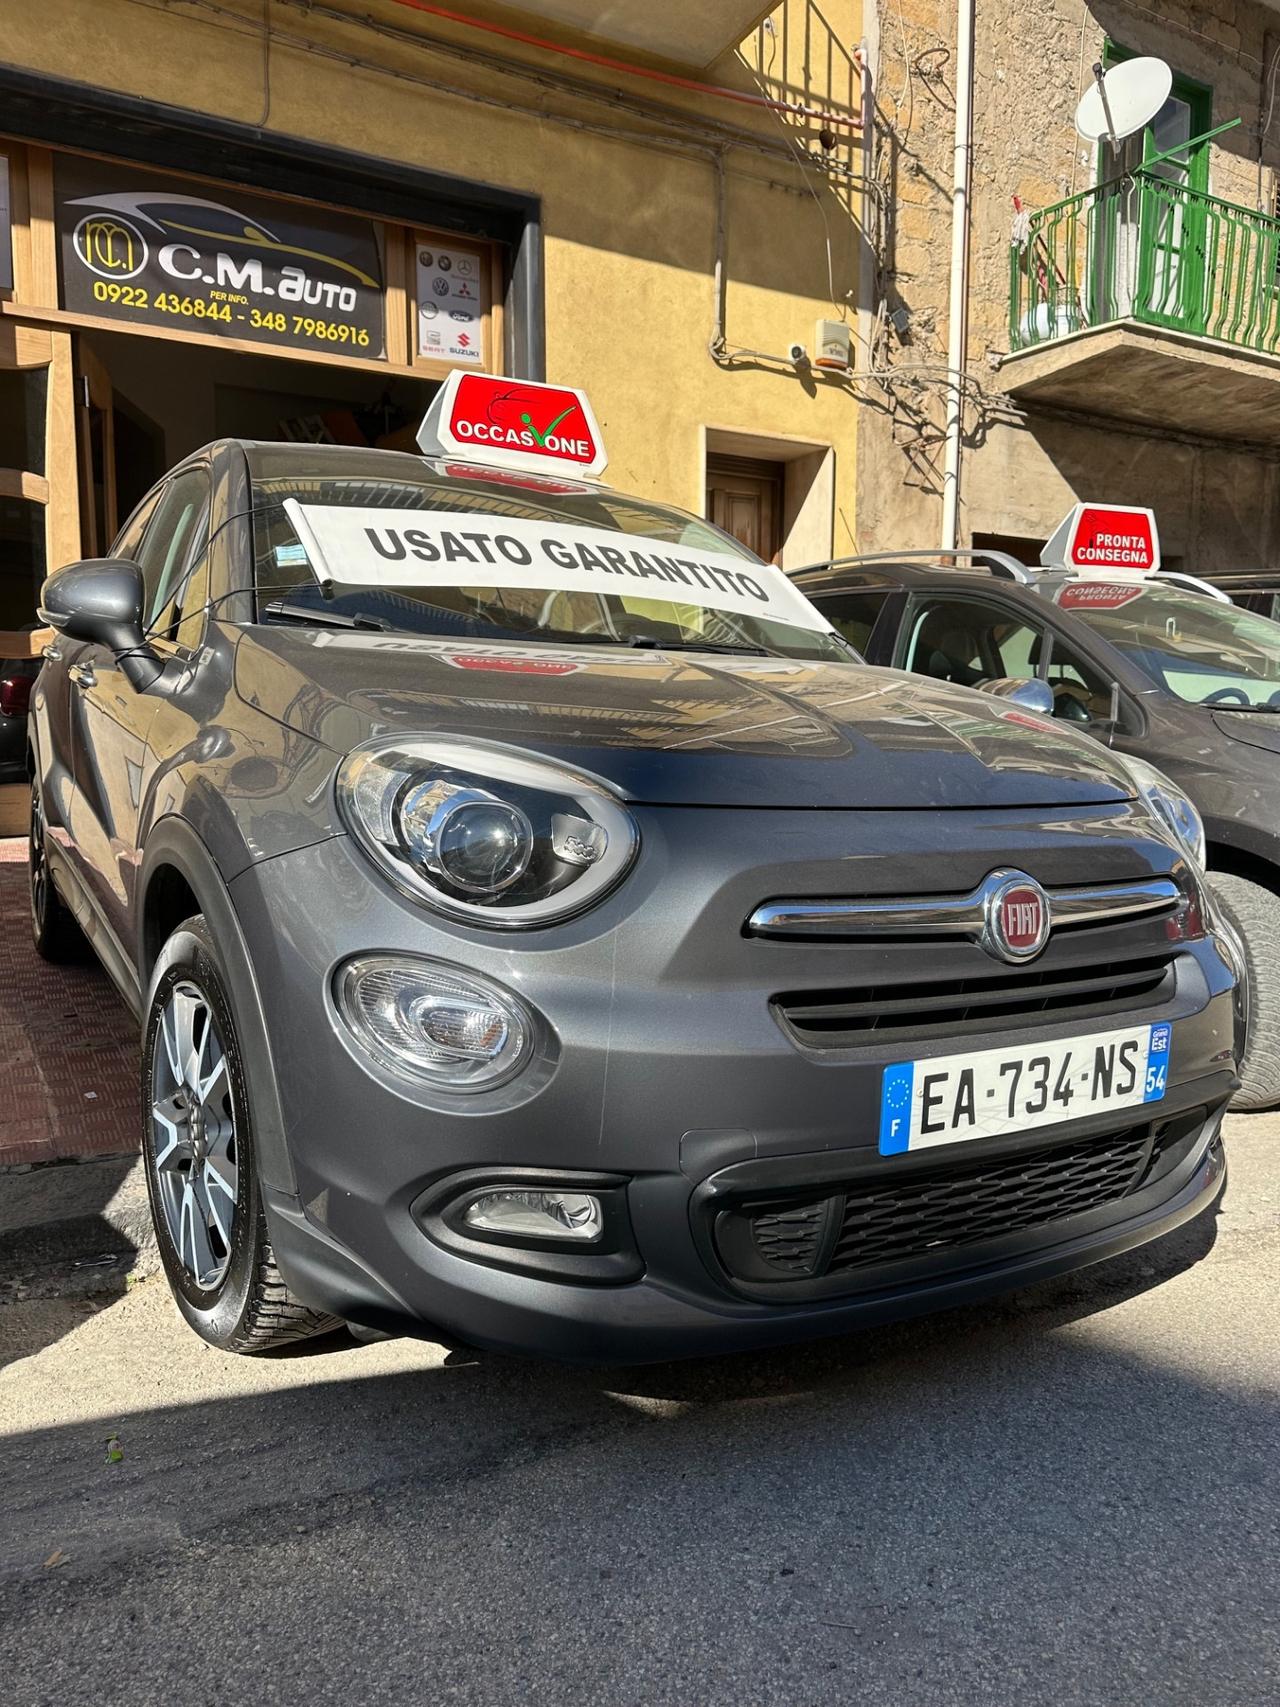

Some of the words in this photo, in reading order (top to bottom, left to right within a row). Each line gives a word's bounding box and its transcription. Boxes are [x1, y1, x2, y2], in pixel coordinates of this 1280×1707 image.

[210, 290, 228, 301] PER
[228, 294, 249, 305] INFO.
[93, 281, 149, 309] 0922
[154, 292, 232, 323] 436844
[250, 309, 287, 332] 348
[292, 315, 370, 346] 7986916
[449, 347, 480, 358] SUZUKI
[1096, 533, 1146, 549] PRONTA
[363, 527, 533, 566] USATO
[540, 538, 770, 602] GARANTITO
[1076, 547, 1148, 564] CONSEGNA
[1007, 902, 1038, 937] FIAT
[1151, 1037, 1167, 1051] Est
[1145, 1064, 1166, 1093] 54
[890, 1118, 901, 1138] F
